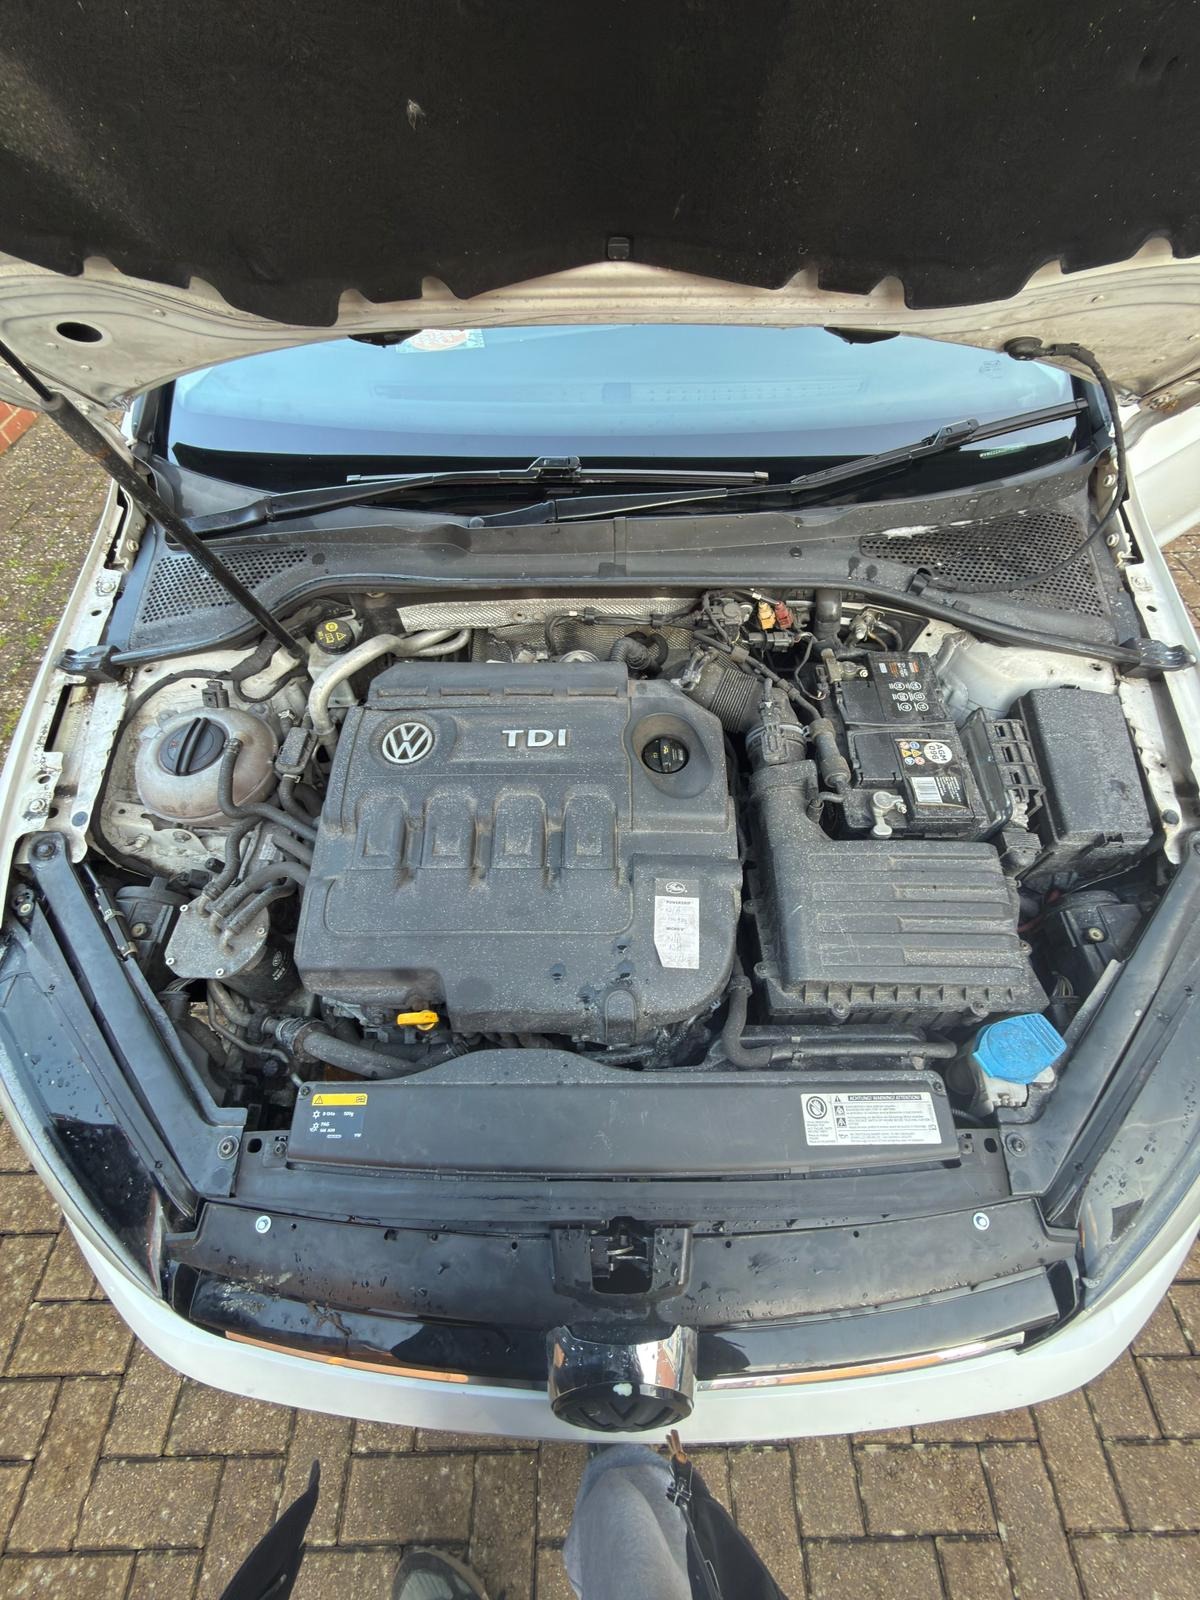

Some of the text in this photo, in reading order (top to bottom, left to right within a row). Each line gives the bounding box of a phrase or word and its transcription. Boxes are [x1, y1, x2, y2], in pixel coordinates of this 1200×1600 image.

[382, 722, 434, 764] VW
[502, 729, 566, 747] TDI
[935, 744, 947, 761] AGM
